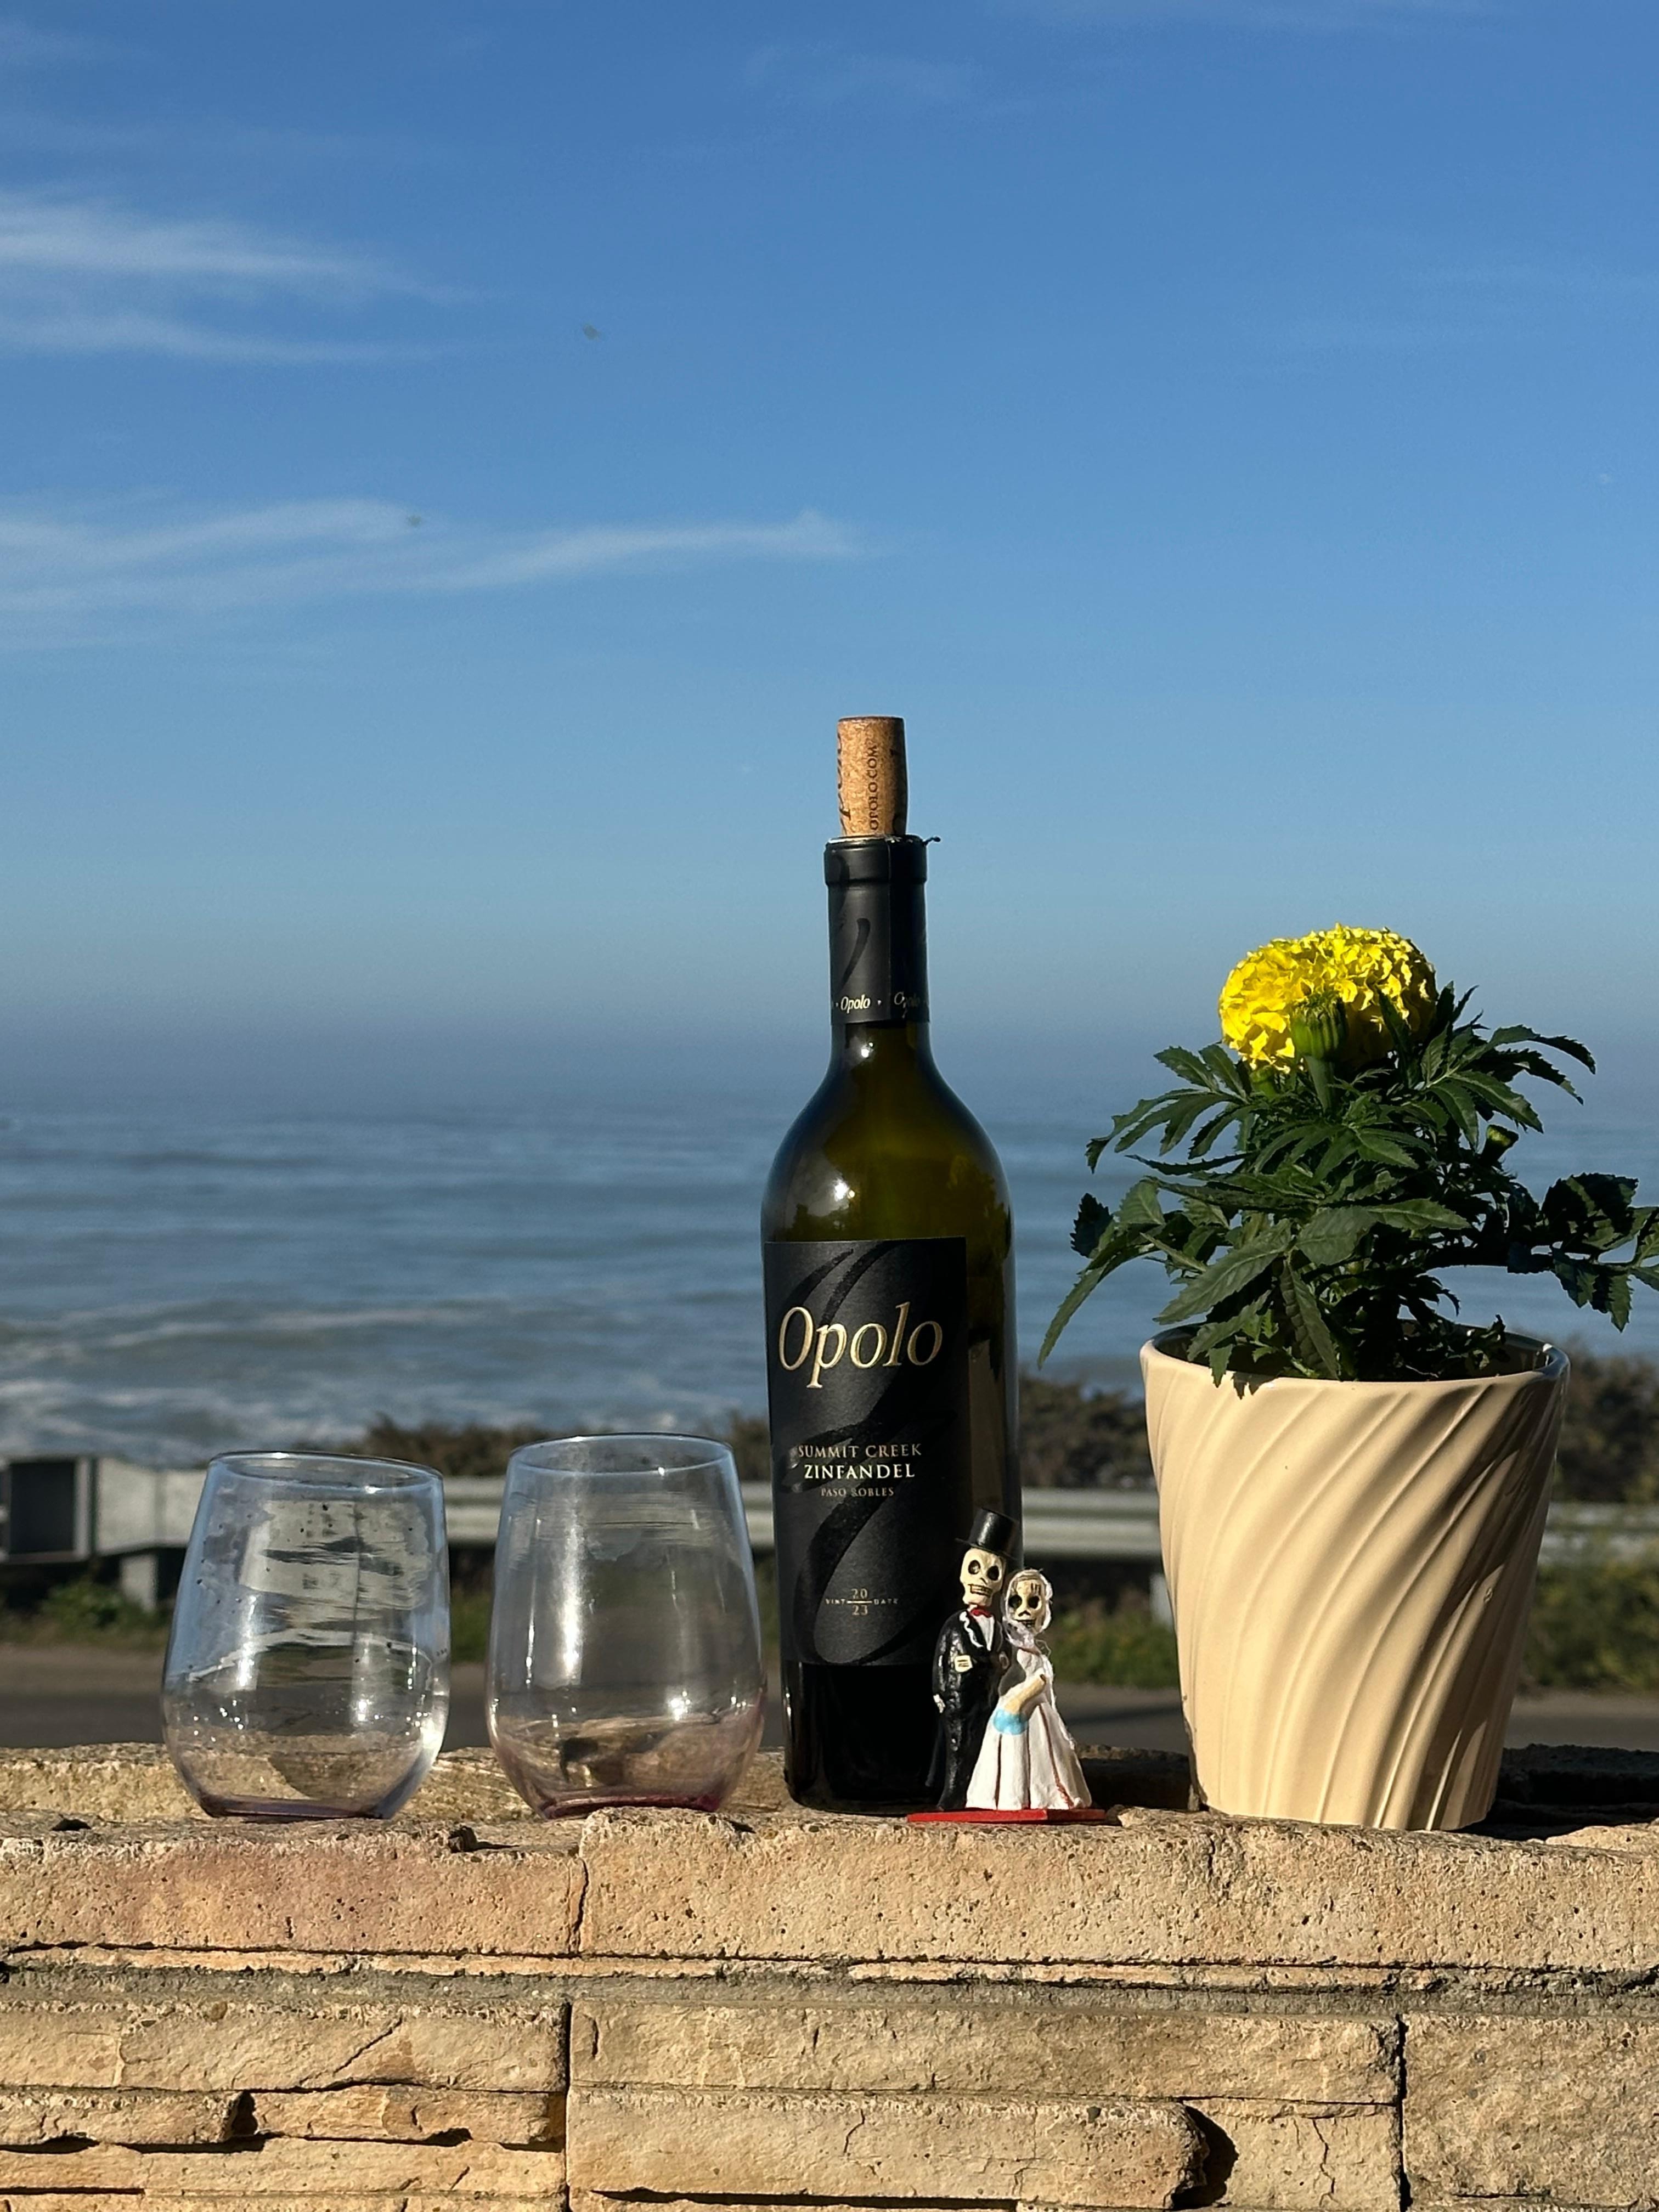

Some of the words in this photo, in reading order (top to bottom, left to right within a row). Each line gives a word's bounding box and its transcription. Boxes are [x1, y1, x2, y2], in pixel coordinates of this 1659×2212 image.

[840, 994, 871, 1014] Opolo
[779, 1302, 943, 1388] Opolo
[798, 1445, 859, 1458] SUMMIT
[865, 1443, 922, 1458] CREEK
[804, 1463, 915, 1479] ZINFANDEL
[821, 1488, 846, 1497] PASO
[851, 1487, 894, 1497] ROBLES
[851, 1588, 868, 1599] 20
[852, 1605, 868, 1615] 23
